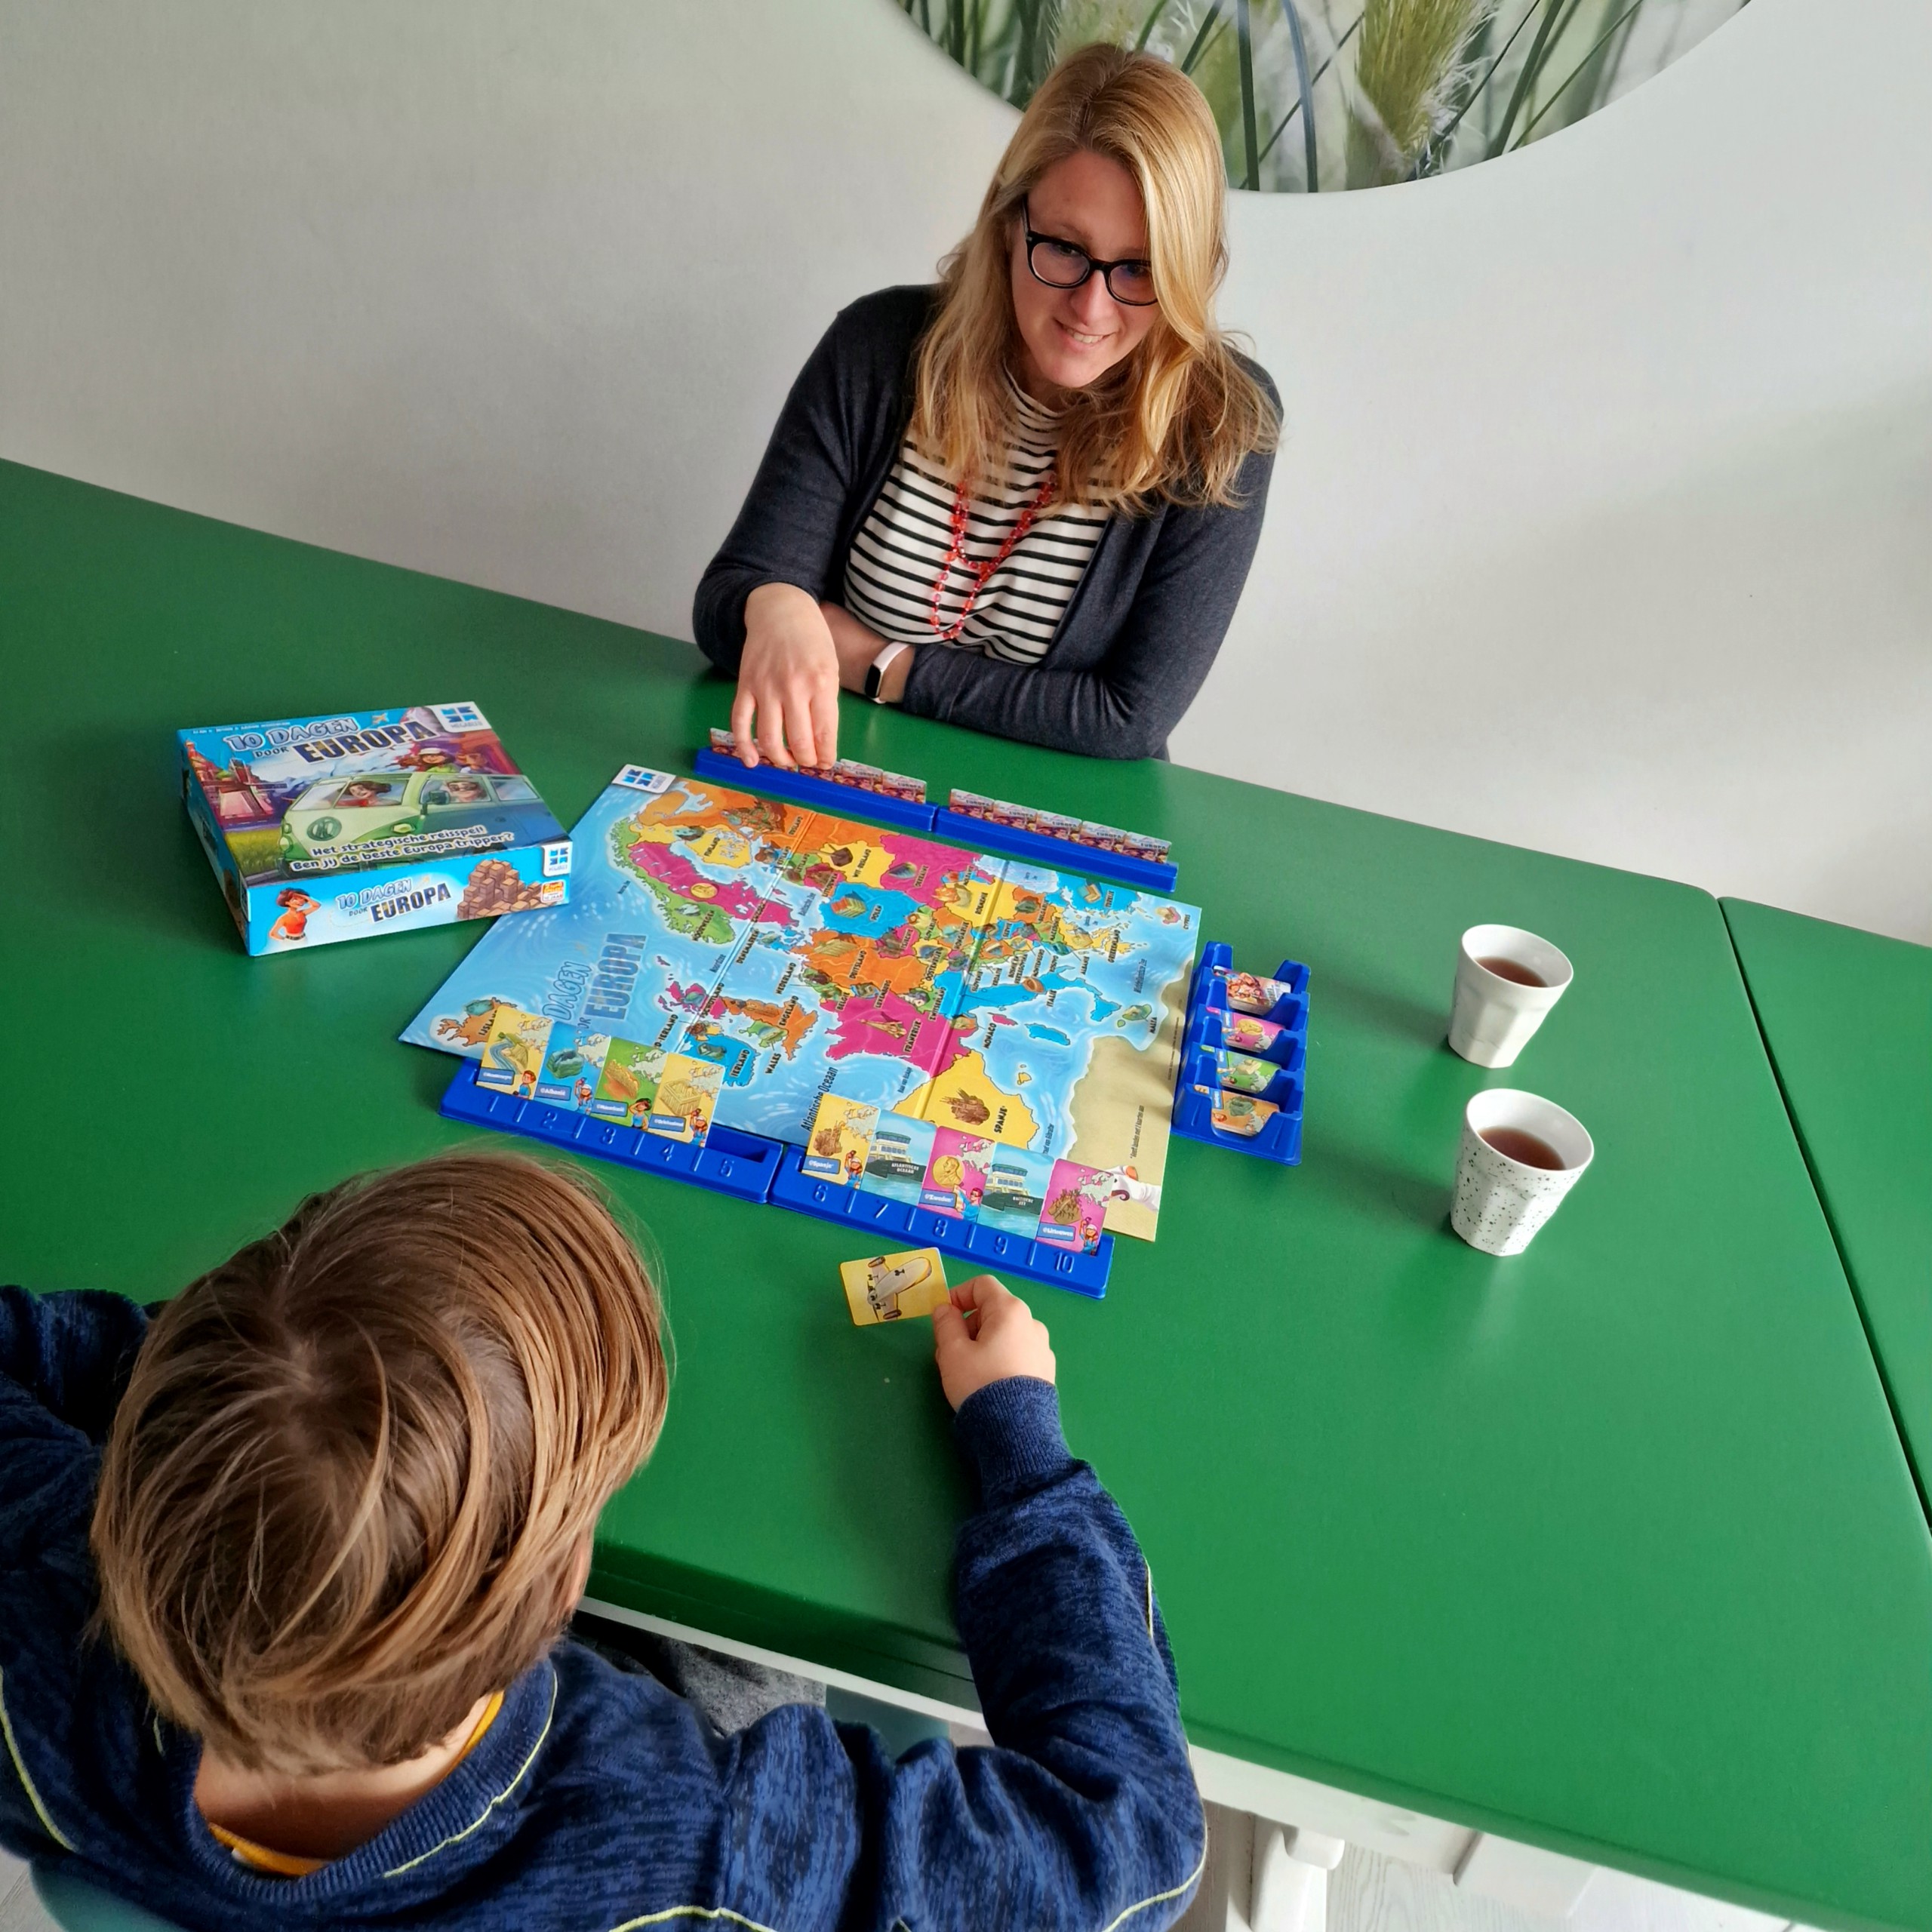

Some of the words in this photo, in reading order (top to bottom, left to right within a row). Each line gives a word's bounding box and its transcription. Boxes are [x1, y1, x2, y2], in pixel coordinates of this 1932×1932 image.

[225, 732, 264, 752] 10
[266, 717, 360, 746] DAGEN
[254, 746, 290, 758] DOOR
[293, 721, 438, 764] EUROPA
[291, 860, 318, 872] Ben
[321, 857, 339, 870] jij
[340, 852, 359, 864] de
[361, 848, 401, 860] beste
[403, 841, 453, 857] Europa
[454, 832, 514, 851] tripper?
[312, 845, 337, 857] Het
[340, 832, 428, 853] strategische
[429, 824, 486, 843] reisspel!
[704, 837, 721, 857] FINLAND
[777, 846, 792, 866] ESTLAND
[797, 854, 810, 873] LETLAND
[336, 892, 357, 909] 10
[358, 877, 413, 905] DAGEN
[349, 906, 368, 916] DOOR
[370, 882, 452, 922] EUROPA
[870, 905, 882, 921] POLEN
[736, 929, 760, 964] DENEMARKEN
[1108, 929, 1121, 964] GRIEKENLAND
[583, 933, 648, 1020] EUROPA
[849, 949, 867, 979] DUITSLAND
[1049, 955, 1059, 972] KOSOVO
[541, 961, 592, 1021] DAGEN
[776, 962, 797, 995] NEDERLAND
[703, 982, 725, 1016] SCHOTLAND
[875, 980, 892, 1008] LUXEMBURG
[929, 986, 947, 1021] ZWITSERLAND
[779, 995, 799, 1026] ENGELAND
[654, 1014, 678, 1048] D-IERLAND
[905, 1020, 922, 1053] FRANKRIJK
[983, 1023, 997, 1050] MONACO
[1149, 1017, 1158, 1034] MALTA
[731, 1049, 750, 1077] IERLAND
[764, 1052, 782, 1075] WALES
[801, 1091, 823, 1132] Atlantische
[817, 1066, 839, 1093] Oceaan
[543, 1111, 558, 1129] 2
[601, 1126, 617, 1145] 3
[662, 1143, 675, 1162] 4
[891, 1162, 919, 1171] ATLANTISCHE
[814, 1183, 828, 1202] 6
[934, 1218, 948, 1238] 8
[995, 1235, 1008, 1255] 9
[1055, 1251, 1075, 1274] 10
